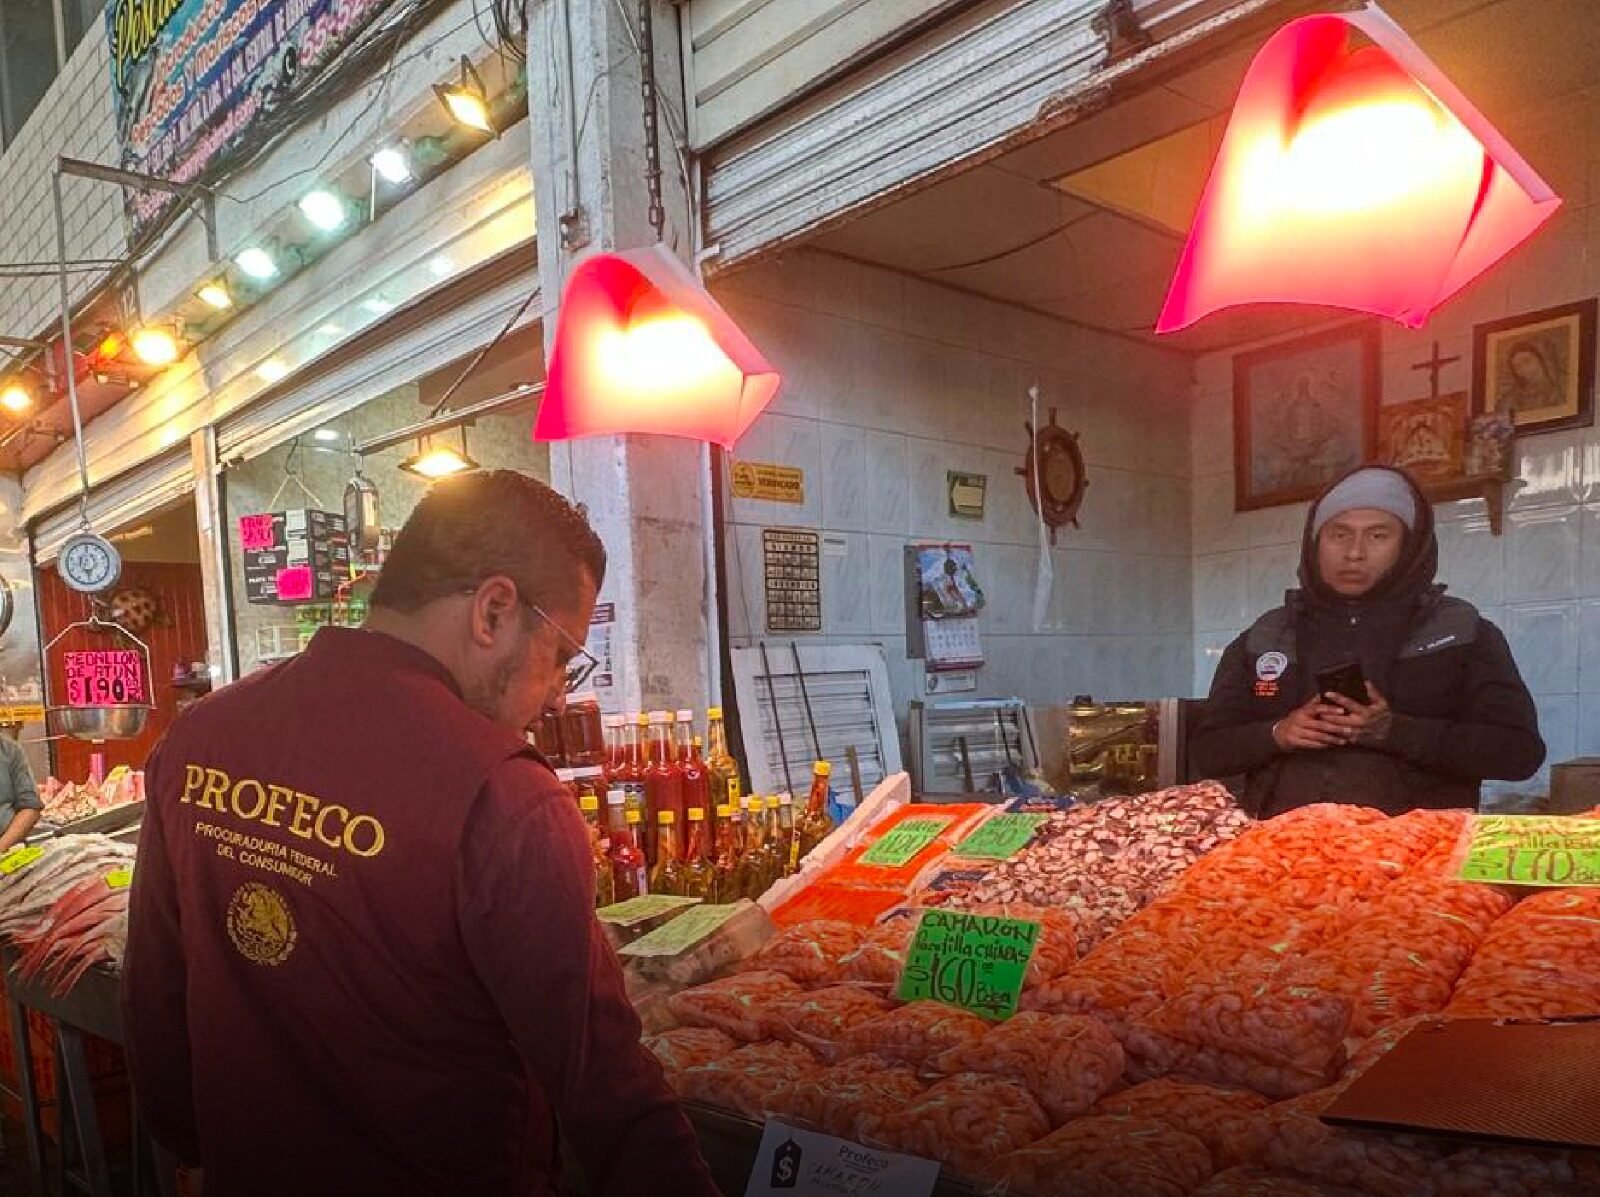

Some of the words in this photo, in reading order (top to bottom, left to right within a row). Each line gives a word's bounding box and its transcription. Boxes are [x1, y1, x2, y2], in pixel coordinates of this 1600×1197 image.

[180, 765, 385, 857] PROFECO
[216, 843, 235, 860] DEL
[290, 848, 338, 877] FEDERAL
